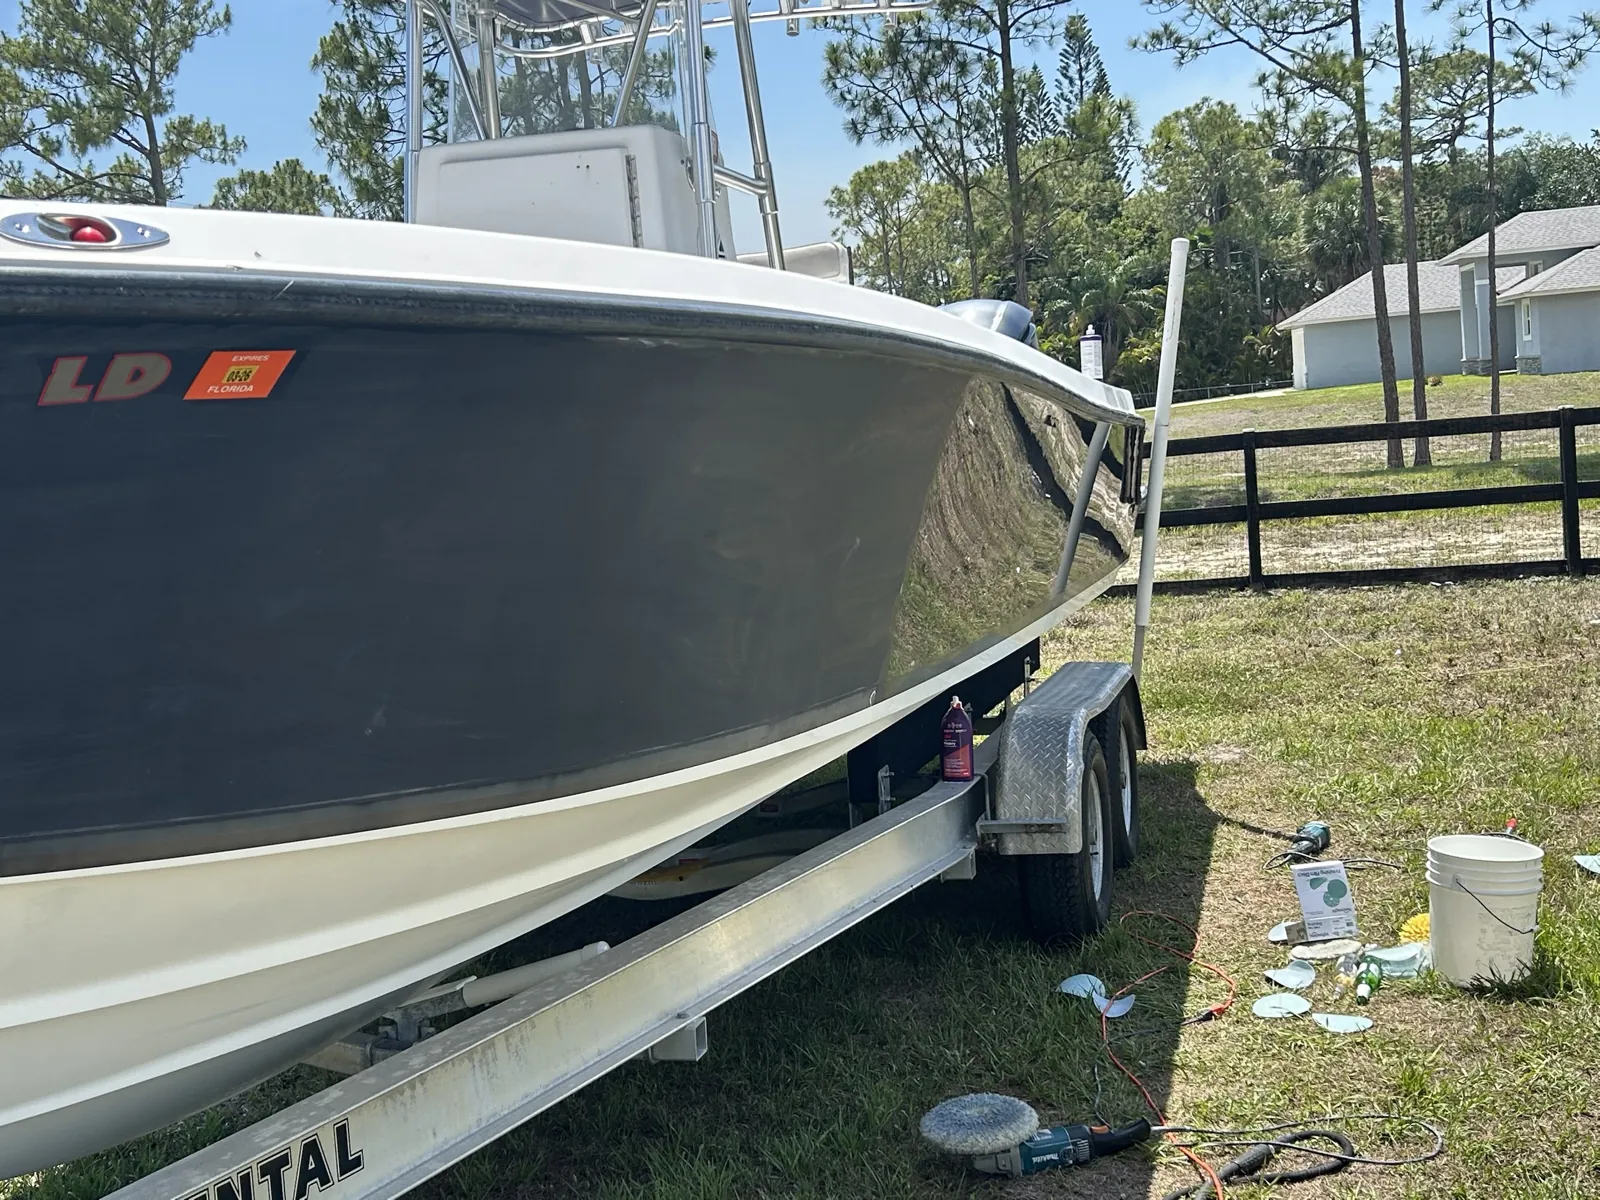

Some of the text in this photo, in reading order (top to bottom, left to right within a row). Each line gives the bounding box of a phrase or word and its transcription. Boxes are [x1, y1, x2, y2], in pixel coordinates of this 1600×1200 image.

[37, 352, 171, 406] LD
[226, 370, 252, 382] 03-26
[207, 385, 254, 393] FLORIDA
